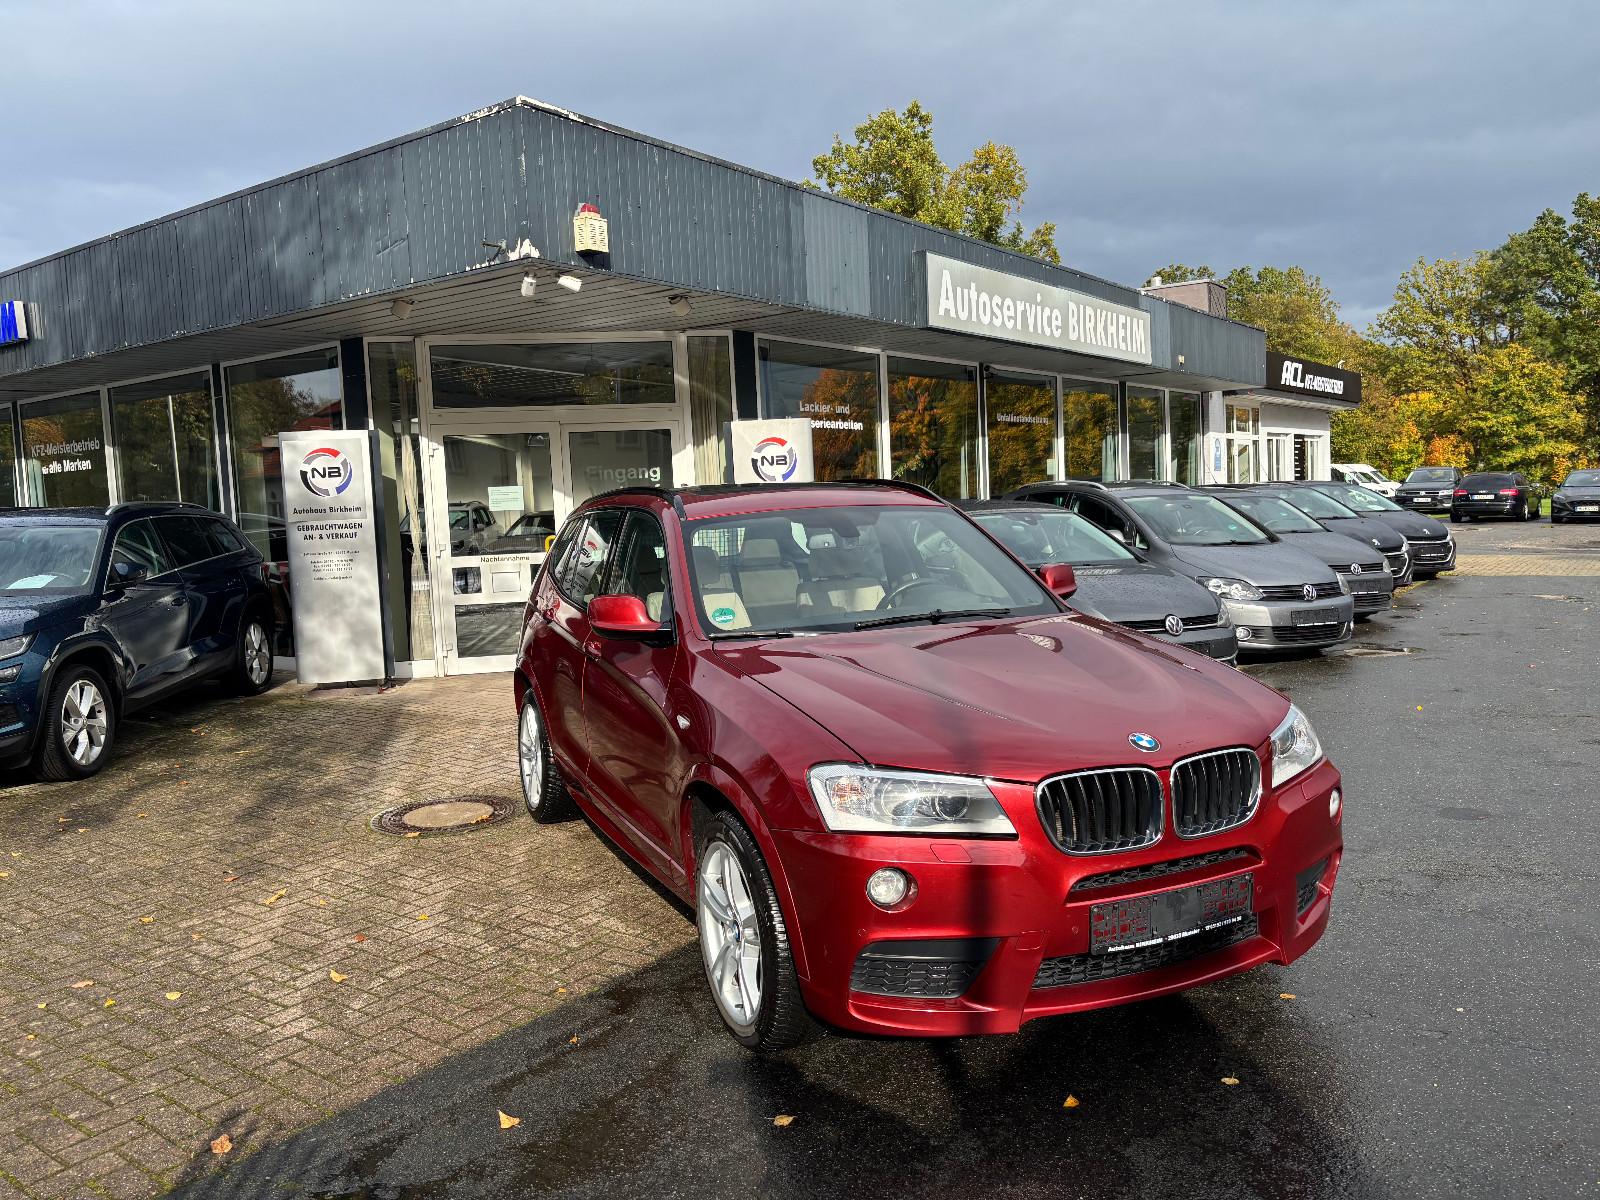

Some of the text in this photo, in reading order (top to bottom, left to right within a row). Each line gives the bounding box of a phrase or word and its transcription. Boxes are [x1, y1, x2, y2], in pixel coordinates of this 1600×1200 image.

[938, 269, 1146, 354] Autoservice BIRKHEIM
[1281, 360, 1304, 388] ACL
[835, 403, 850, 414] und
[30, 437, 100, 458] KFZ-Meisterbetrieb
[49, 461, 62, 474] alle
[63, 458, 92, 472] Marken
[761, 454, 788, 467] NB
[311, 466, 342, 479] NB
[585, 466, 660, 483] Eingang
[293, 505, 362, 516] Autohaus Birkheim
[297, 522, 364, 532] GEBRAUCHTWAGEN
[326, 532, 358, 541] VERKAUF
